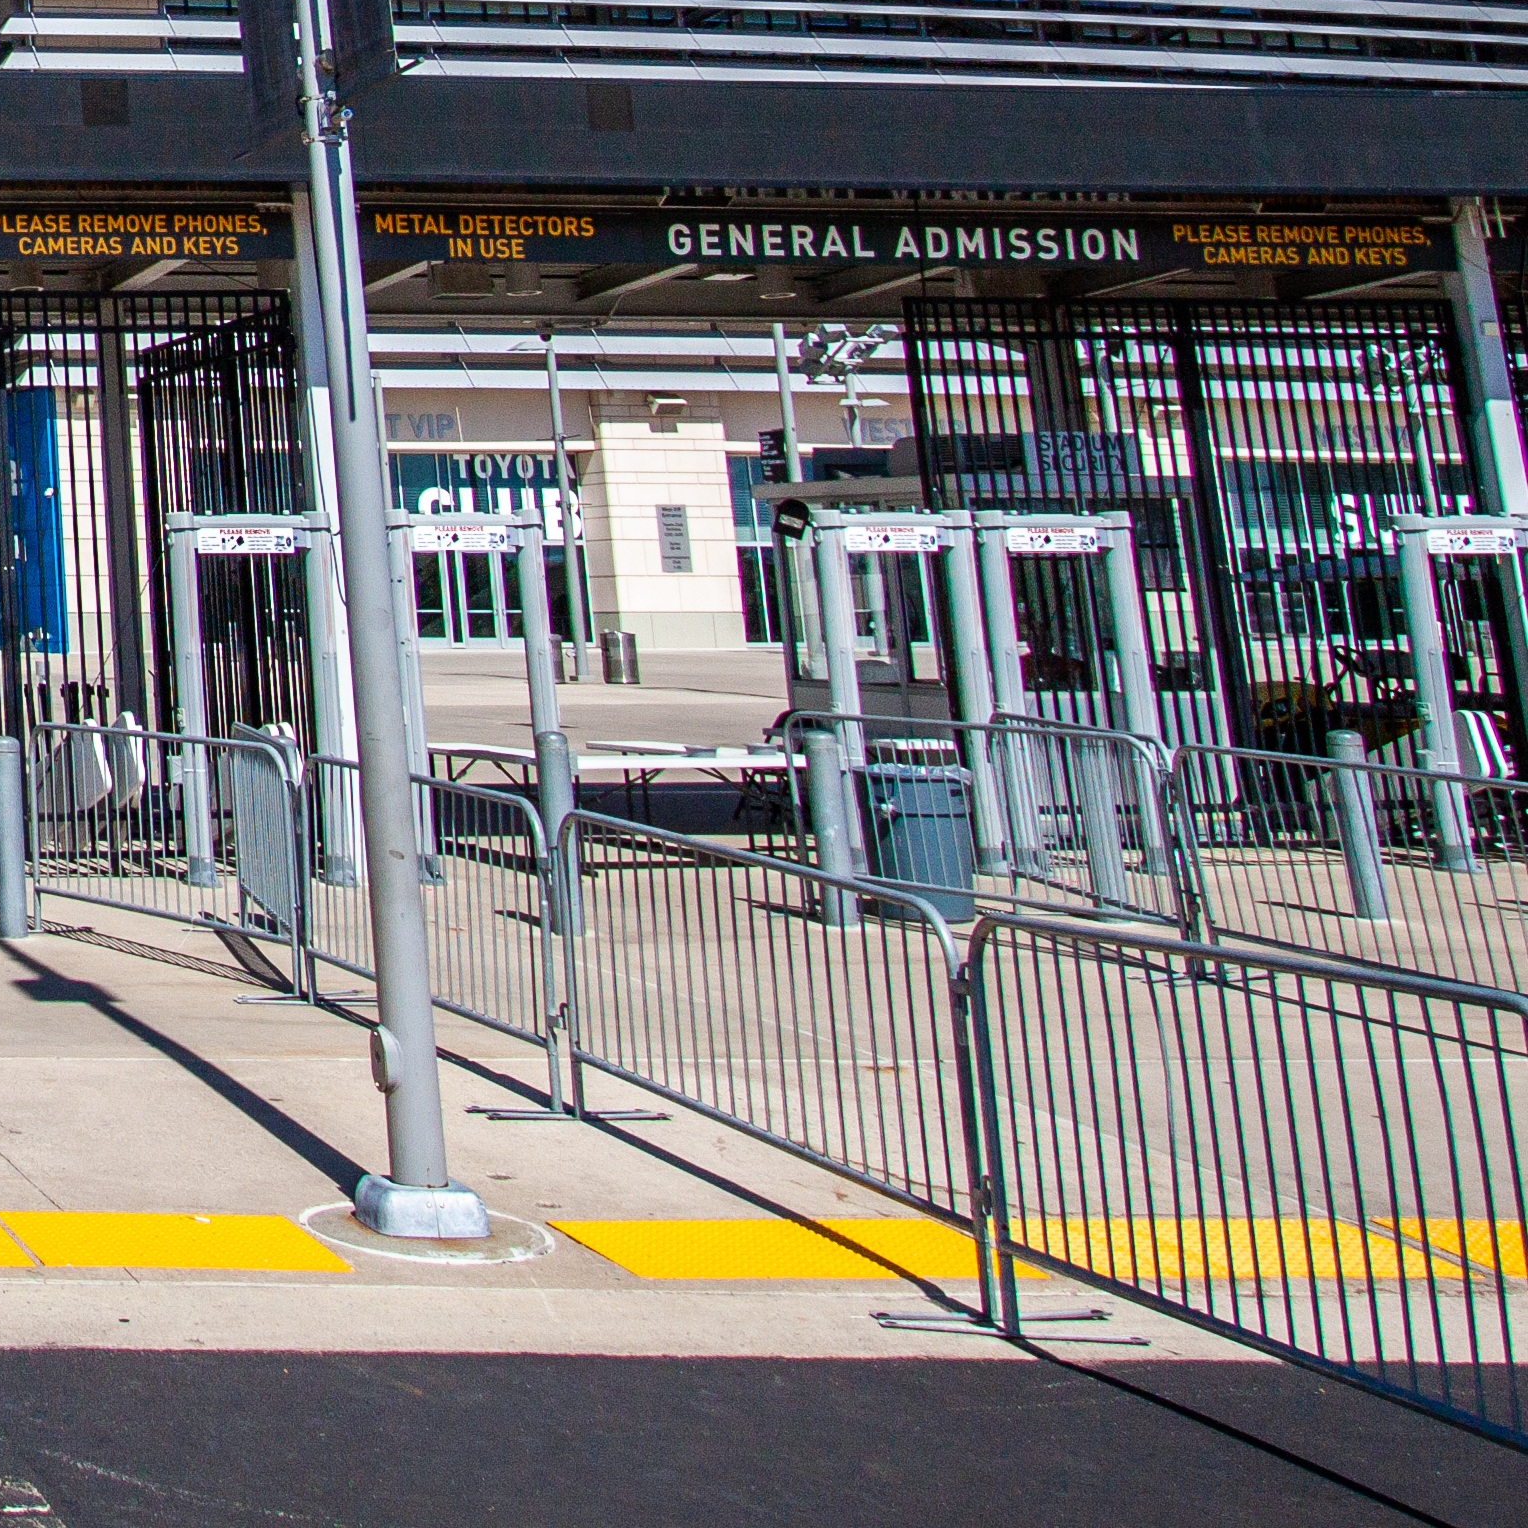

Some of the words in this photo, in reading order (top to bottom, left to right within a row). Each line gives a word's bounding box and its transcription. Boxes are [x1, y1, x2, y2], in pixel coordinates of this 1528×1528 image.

[78, 214, 168, 233] REMOVE
[174, 214, 268, 236] PHONES,
[374, 213, 452, 235] METAL
[459, 214, 594, 237] DETECTORS
[1173, 224, 1252, 243] PLEASE
[1256, 225, 1339, 244] REMOVE
[1345, 226, 1432, 247] PHONES,
[18, 236, 122, 255] CAMERAS
[130, 236, 177, 255] AND
[183, 236, 239, 255] KEYS
[449, 238, 473, 258] IN
[480, 238, 525, 259] USE
[667, 223, 875, 258] GENERAL
[894, 226, 1140, 261] ADMISSION
[1203, 247, 1300, 265] CAMERAS
[1307, 247, 1350, 265] AND
[1355, 248, 1408, 266] KEYS
[407, 413, 455, 439] VIP
